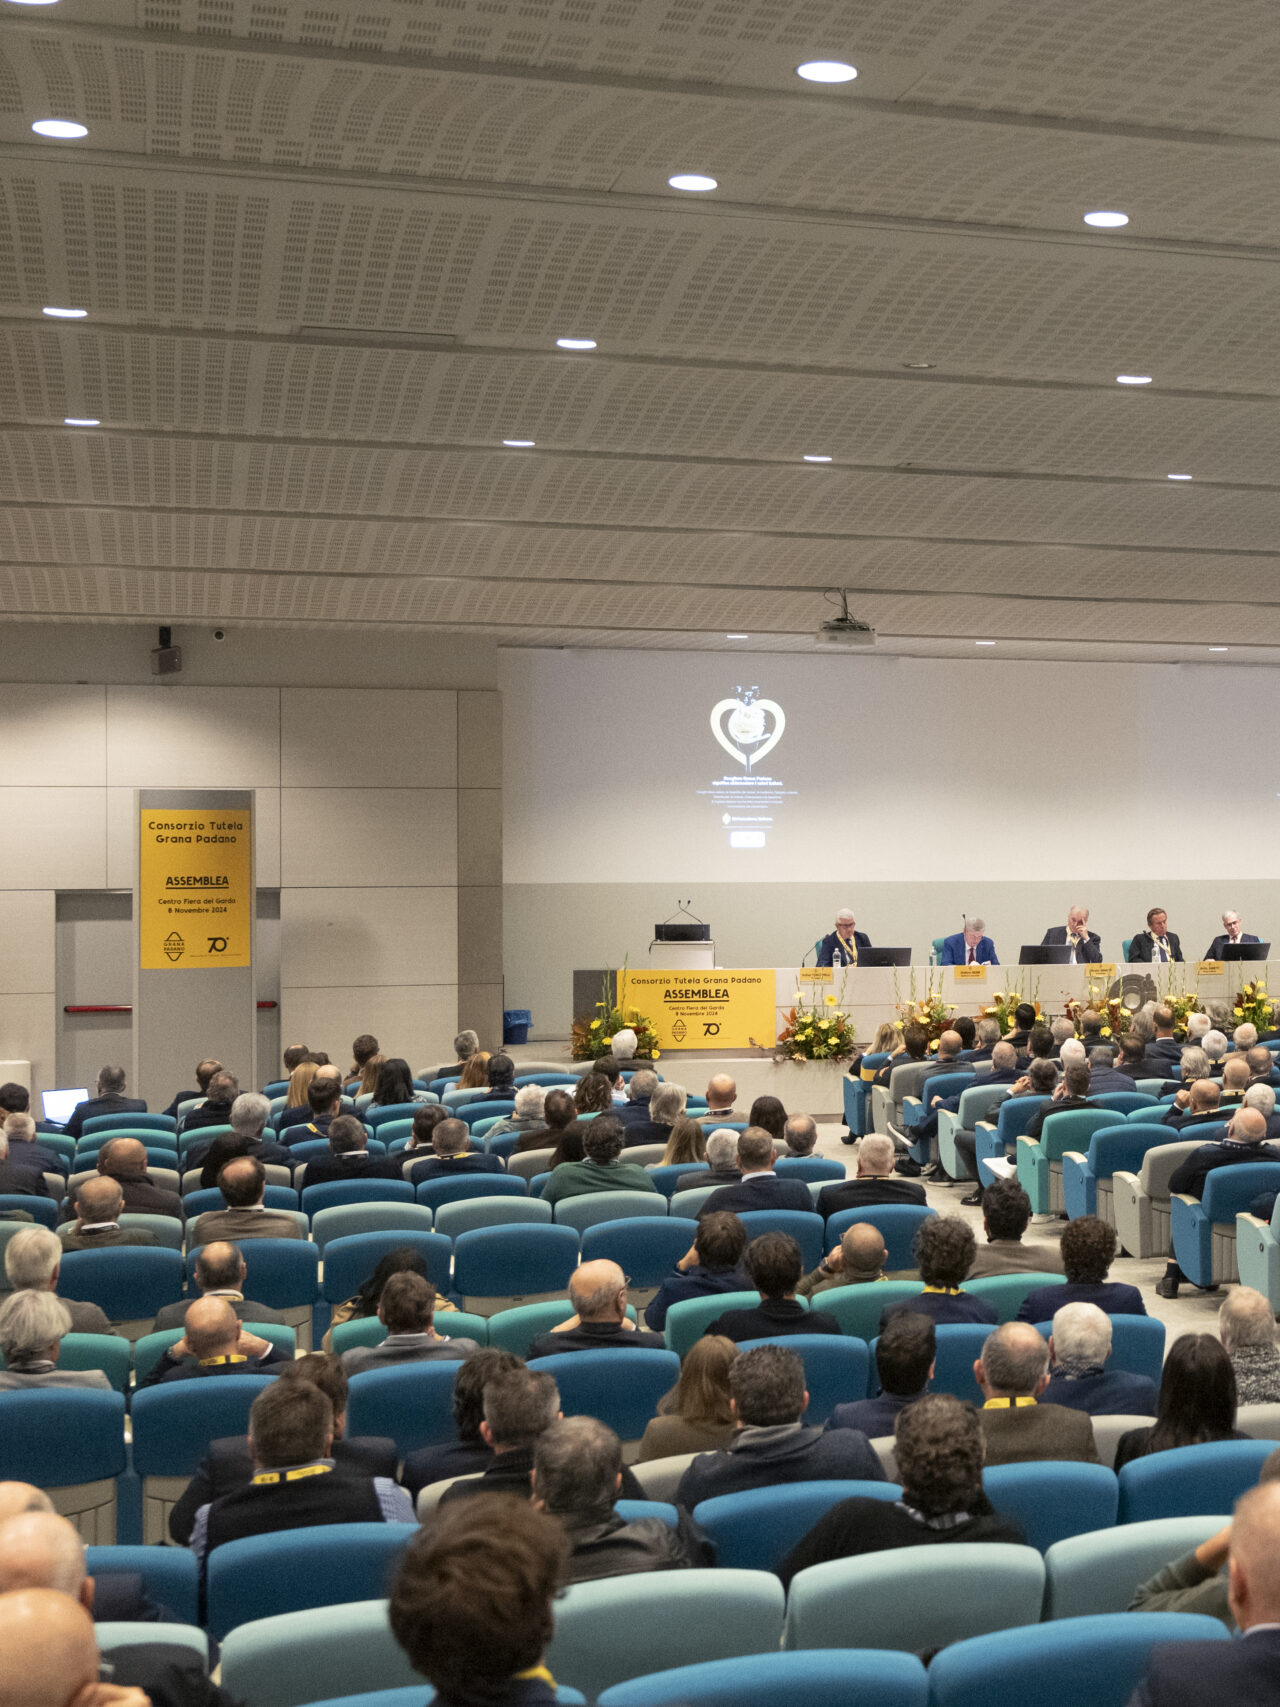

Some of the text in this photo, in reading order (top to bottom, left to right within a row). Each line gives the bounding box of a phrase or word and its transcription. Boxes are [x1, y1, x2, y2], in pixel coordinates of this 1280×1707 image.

[148, 821, 243, 831] Consorzio Tutela
[155, 834, 237, 843] Grana Padano
[165, 876, 229, 886] ASSEMBLEA
[631, 977, 671, 985] Consorzio
[731, 976, 762, 984] Padano
[664, 988, 730, 999] ASSEMBLEA
